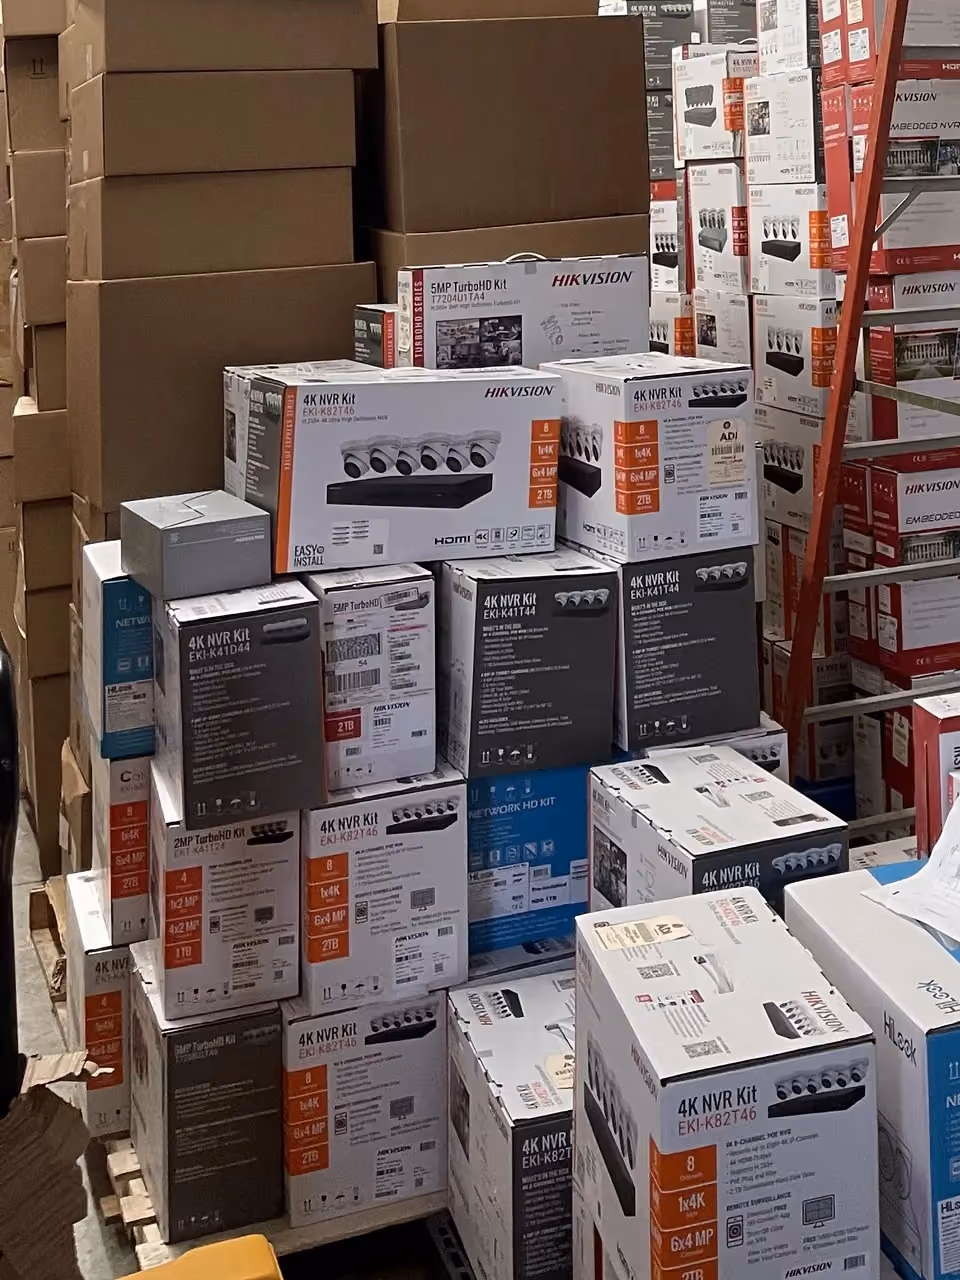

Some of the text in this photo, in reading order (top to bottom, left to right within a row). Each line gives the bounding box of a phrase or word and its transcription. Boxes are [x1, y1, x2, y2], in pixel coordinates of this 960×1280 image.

[552, 270, 633, 288] HIKVISION
[430, 279, 507, 295] 5MP TurboHD Kit
[902, 282, 957, 296] HIKVISION
[413, 280, 424, 359] TURBOHD SERIES
[303, 393, 356, 406] 4K NVR Kit
[484, 385, 554, 399] HIKVISION
[633, 386, 682, 402] 4K NVR Kit
[302, 406, 355, 417] EKI-K82T46
[720, 431, 738, 442] ADI
[634, 446, 652, 458] 1x4K
[537, 489, 552, 500] 2TB
[905, 480, 960, 495] HIKVISION
[637, 494, 651, 506] 2TB
[905, 511, 960, 525] EMBEDDED
[434, 535, 472, 546] HDMI
[294, 545, 317, 557] EASY
[294, 556, 324, 568] INSTALL
[630, 571, 680, 589] 4K NVR Kit
[630, 583, 680, 600] EKI-K41T44
[333, 598, 379, 613] 5MP TurboHD
[484, 593, 537, 609] 4K NVR Kit
[483, 606, 536, 620] EKI-K41T44
[188, 627, 250, 650] 4K NVR Kit
[188, 642, 250, 663] EKI-K41D44
[337, 721, 354, 732] 2TB
[522, 799, 538, 811] HD
[540, 796, 556, 807] KIT
[320, 812, 378, 835] 4K NVR Kit
[174, 827, 245, 849] 2MP TurboHD Kit
[320, 828, 378, 847] EKI-K82T46
[657, 843, 689, 880] HIKVISION
[702, 872, 717, 887] 4K
[720, 866, 742, 884] NVR
[744, 863, 760, 878] Kit
[123, 877, 139, 889] 2TB
[320, 885, 340, 899] 1x4K
[322, 938, 338, 952] 2TB
[95, 960, 109, 974] 4K
[801, 990, 848, 1033] HIKVISION
[299, 1023, 357, 1047] 4K NVR Kit
[299, 1040, 357, 1059] EKI-K82T46
[299, 1096, 320, 1111] 1x4K
[678, 1085, 757, 1118] 4K NVR Kit
[678, 1107, 757, 1136] EKI-K82T46
[522, 1132, 566, 1154] 4K NVR
[302, 1151, 318, 1164] 2TB
[678, 1192, 705, 1213] 1x4K
[671, 1234, 694, 1252] 6x4
[785, 1261, 833, 1279] HIKVISION
